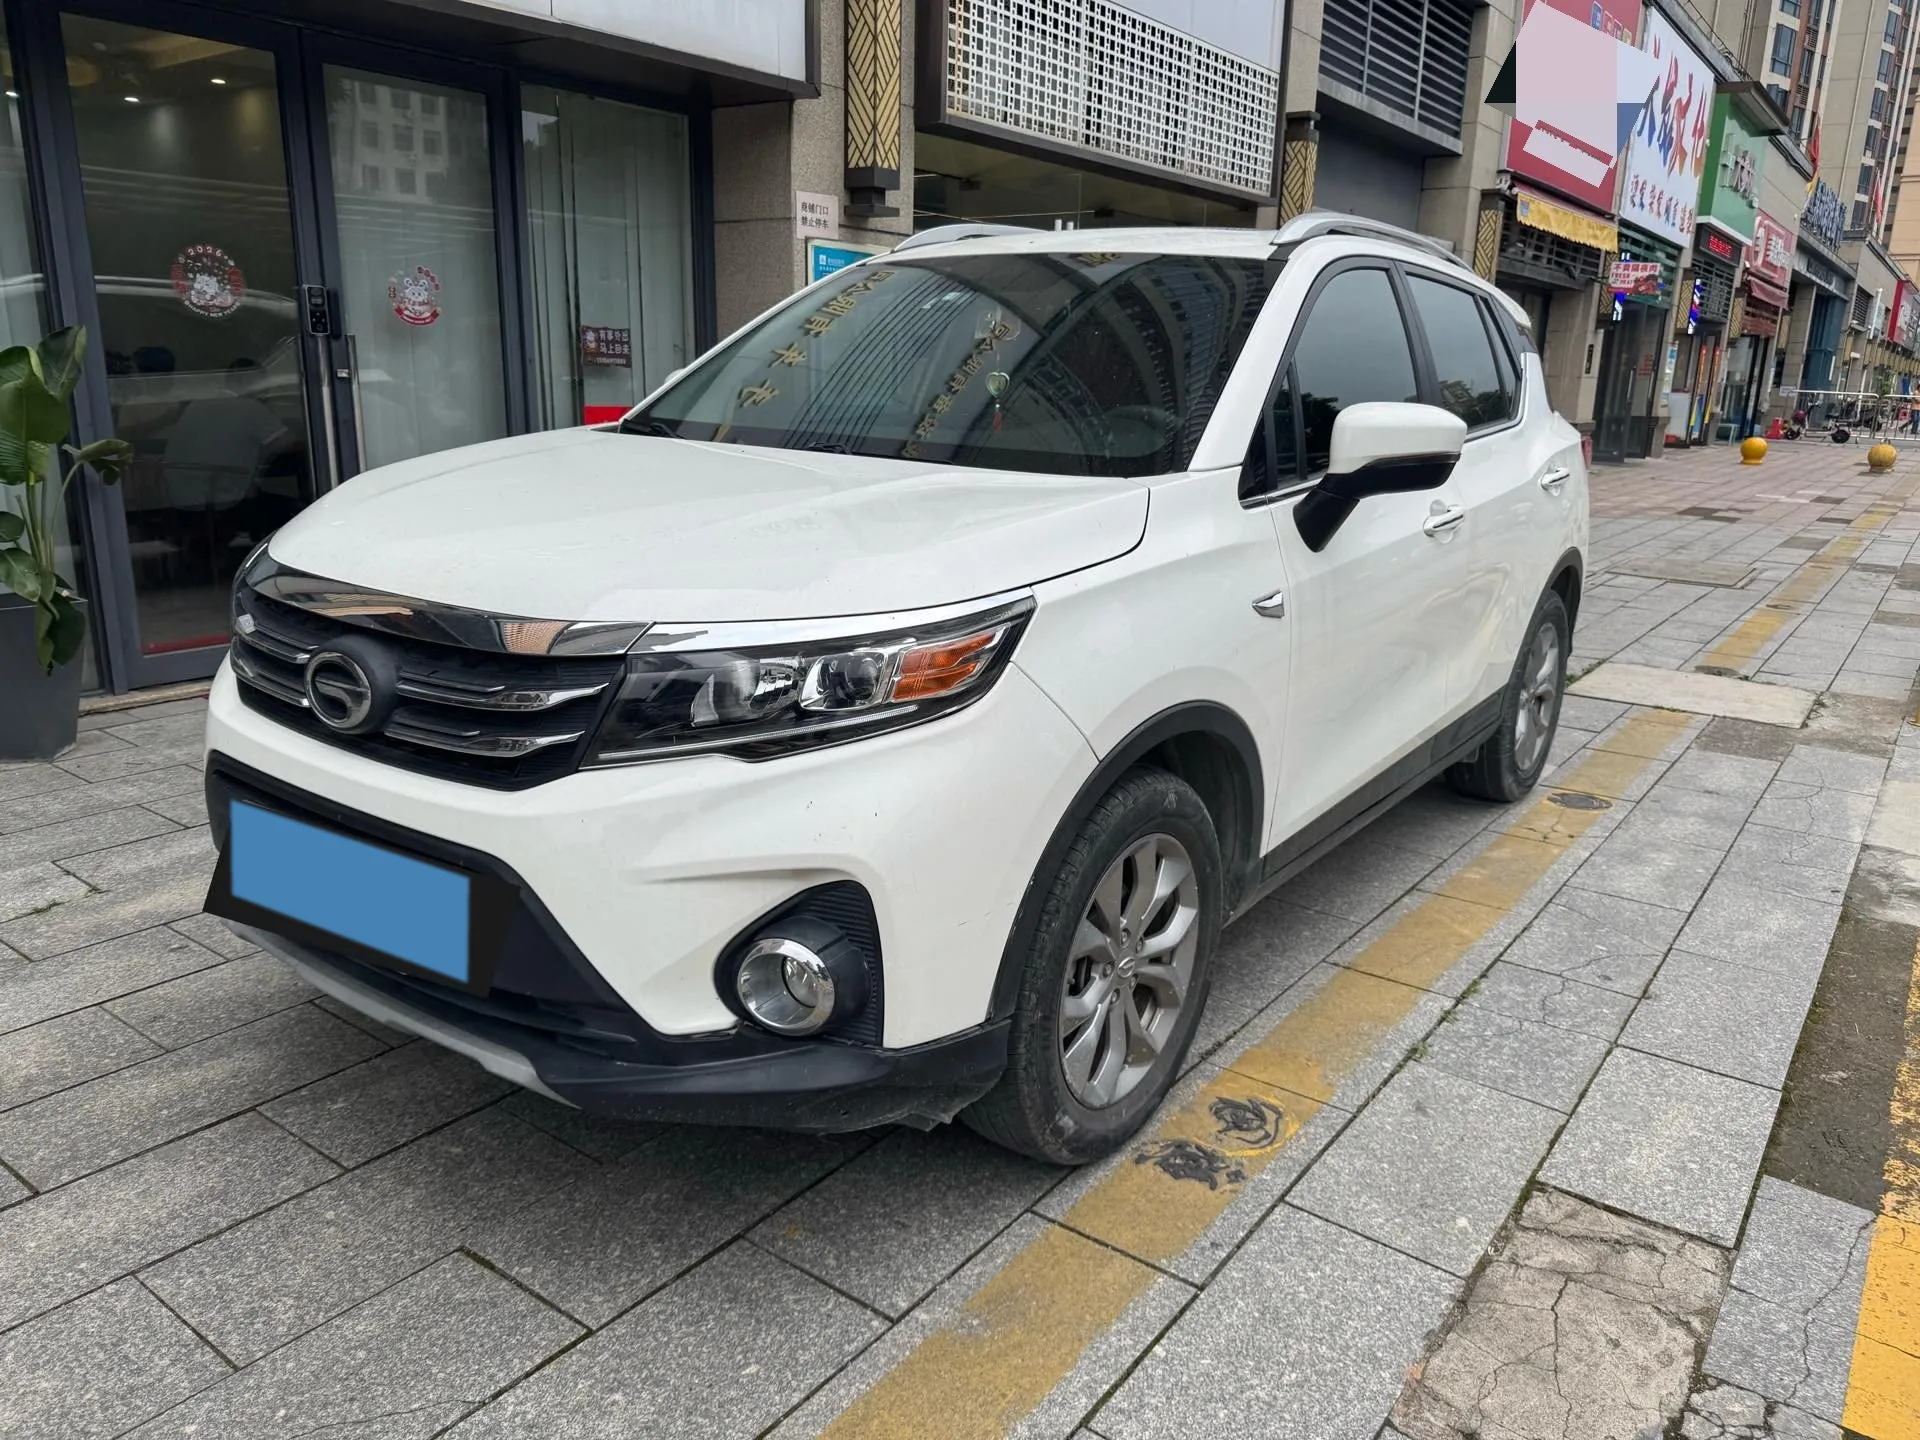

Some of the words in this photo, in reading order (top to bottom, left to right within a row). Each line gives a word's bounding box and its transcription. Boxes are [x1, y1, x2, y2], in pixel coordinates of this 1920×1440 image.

[801, 202, 829, 215] 商铺门口
[801, 216, 829, 230] 禁止停车
[187, 245, 222, 257] 2026
[599, 330, 629, 342] 有事外出
[599, 342, 630, 355] 马上回来
